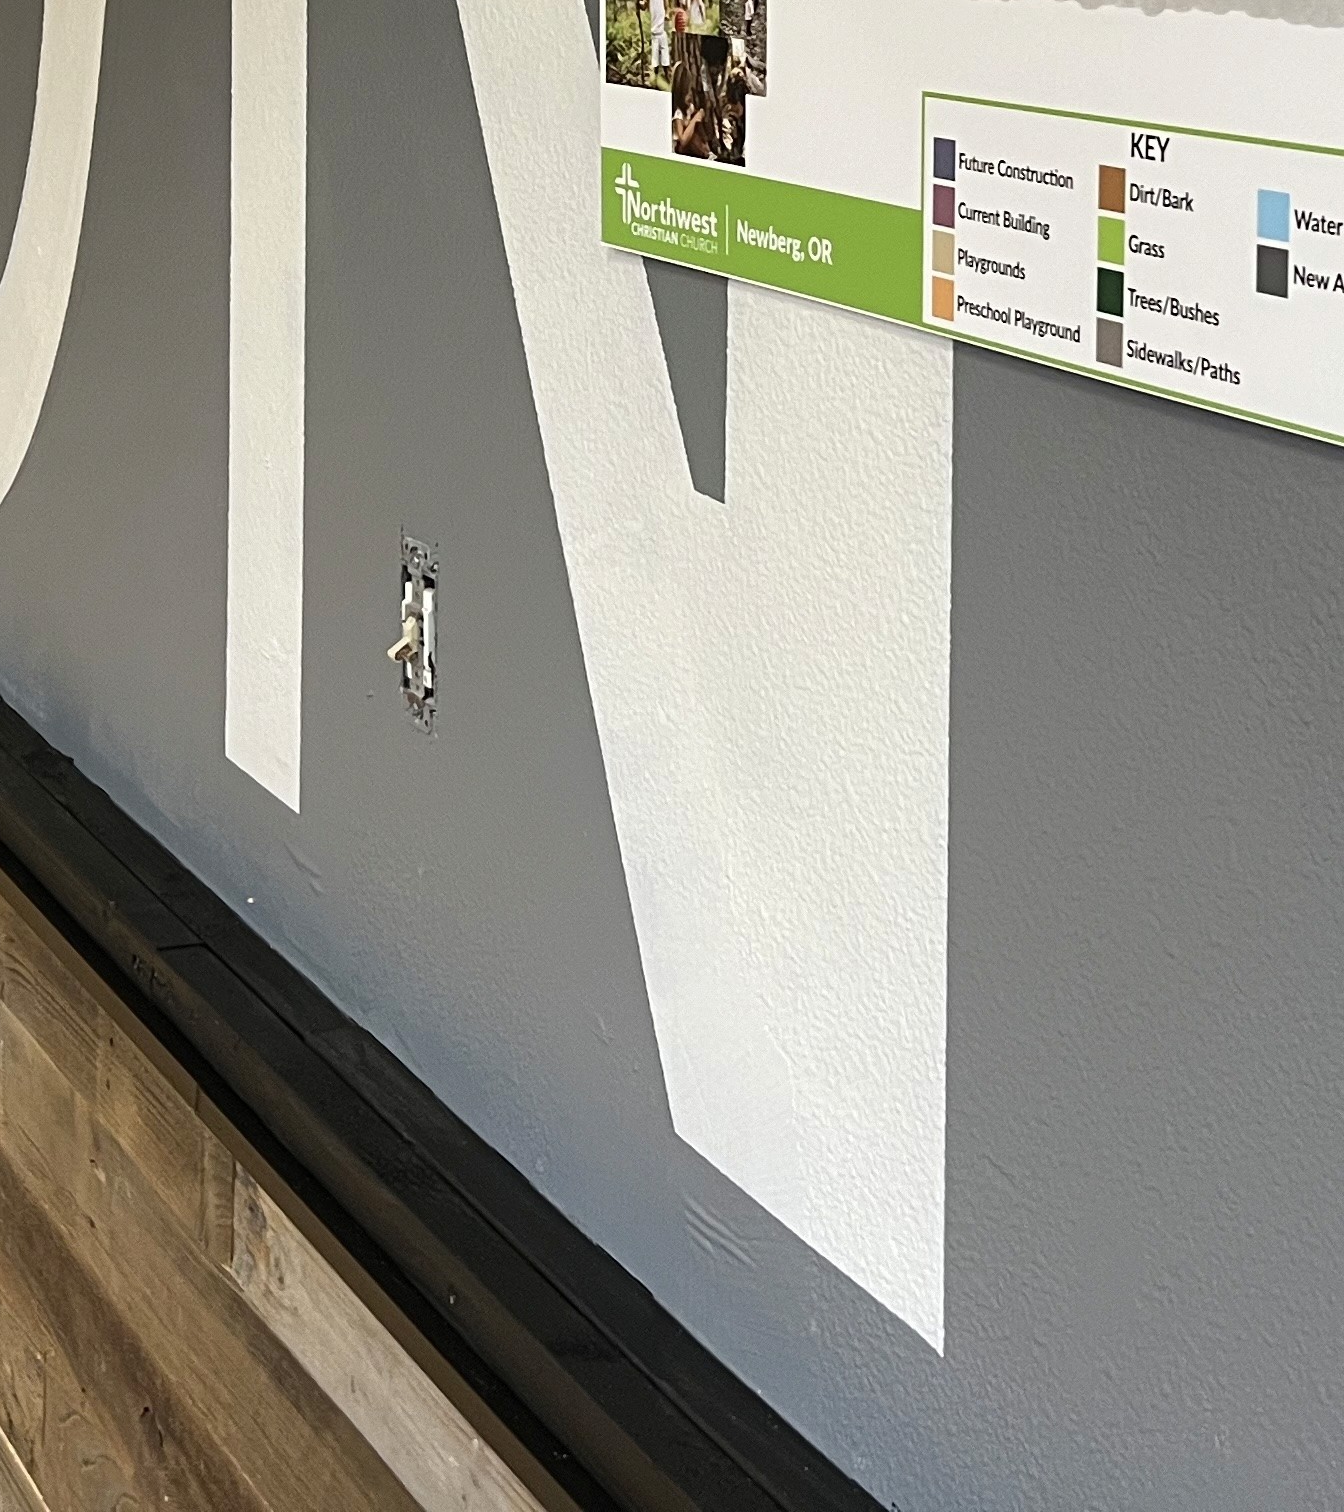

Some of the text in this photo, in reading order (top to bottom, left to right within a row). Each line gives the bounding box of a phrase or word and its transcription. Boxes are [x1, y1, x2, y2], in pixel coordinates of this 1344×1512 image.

[1130, 133, 1170, 163] KEY
[958, 153, 1074, 190] Future Construction
[627, 189, 718, 237] Northwest
[1129, 184, 1195, 212] Dirt/Bark
[631, 222, 718, 254] CHRISTIAN CHURCH
[957, 202, 1050, 240] Current Building
[1294, 209, 1344, 237] Water
[736, 219, 833, 265] Newberg, OR
[1128, 235, 1166, 260] Grass
[957, 249, 1026, 281] Playgrounds
[1293, 265, 1330, 291] New
[957, 295, 1081, 345] Preschool Playground
[1127, 287, 1221, 326] Trees/Bushes
[1126, 339, 1241, 386] Sidewalks/Paths
